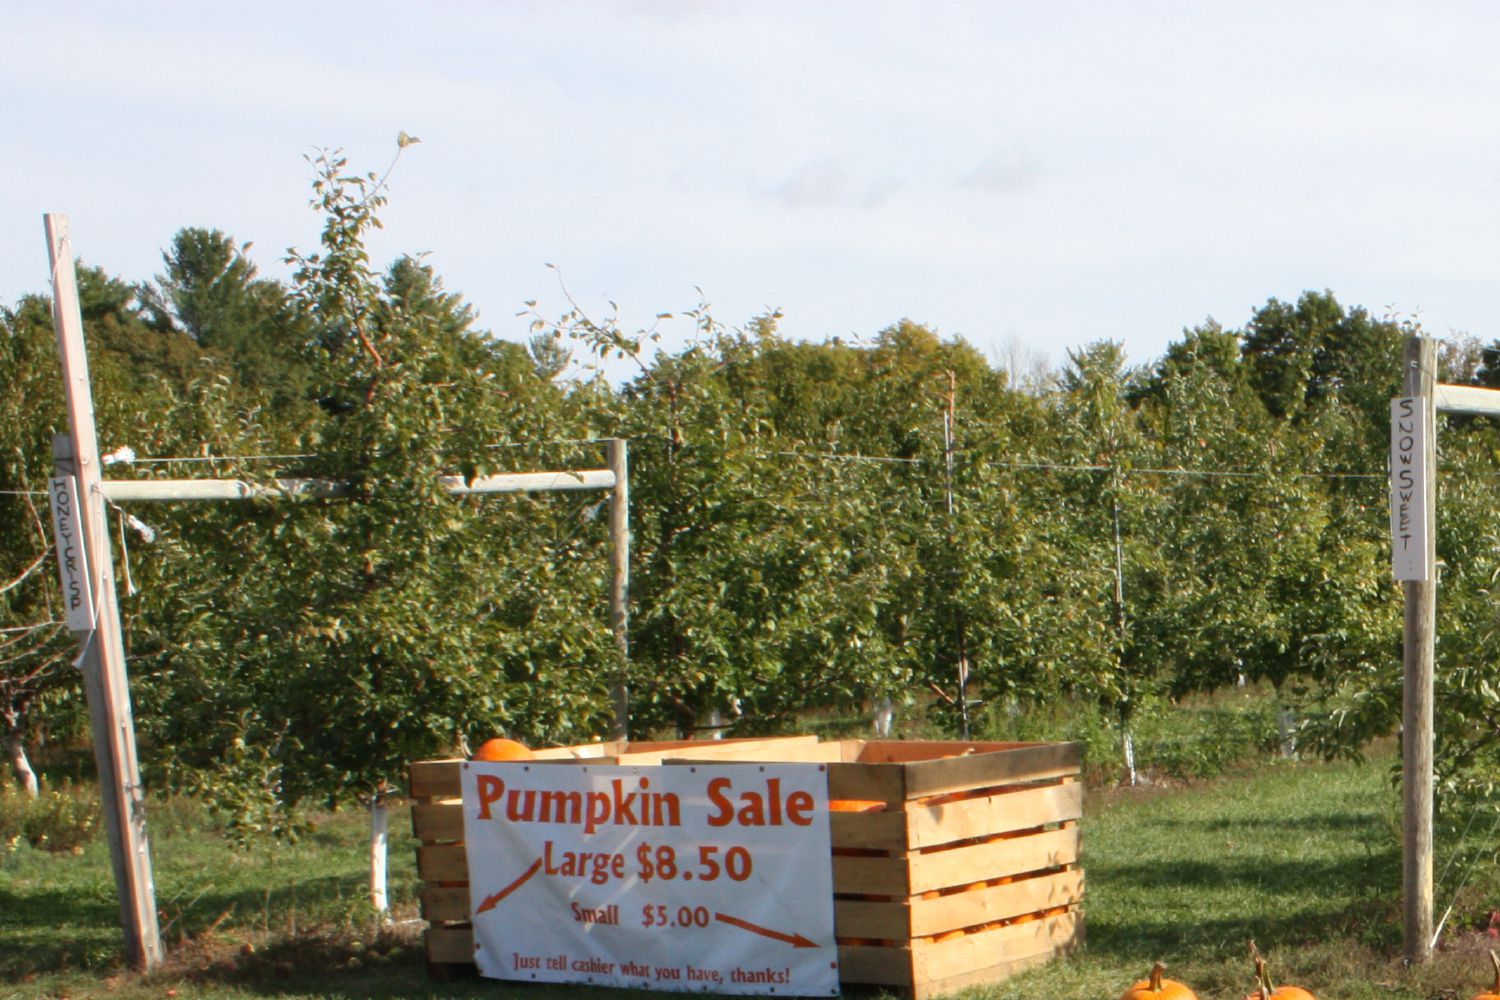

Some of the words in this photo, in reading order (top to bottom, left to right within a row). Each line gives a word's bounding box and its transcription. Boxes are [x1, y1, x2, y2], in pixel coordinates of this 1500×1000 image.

[1399, 399, 1414, 550] SNOWSWEET
[53, 480, 81, 610] HONEYCRISP
[476, 774, 681, 834] Pumpkin
[706, 777, 815, 828] Sale
[544, 841, 625, 885] Large
[637, 842, 753, 884] $8.50
[570, 902, 619, 926] Small
[641, 904, 710, 928] $5.00
[512, 953, 541, 971] Just
[546, 954, 567, 971] tell
[571, 956, 615, 975] cashier
[620, 960, 650, 978] what
[654, 966, 680, 982] you
[687, 965, 724, 985] have,
[730, 967, 791, 984] thanks!
